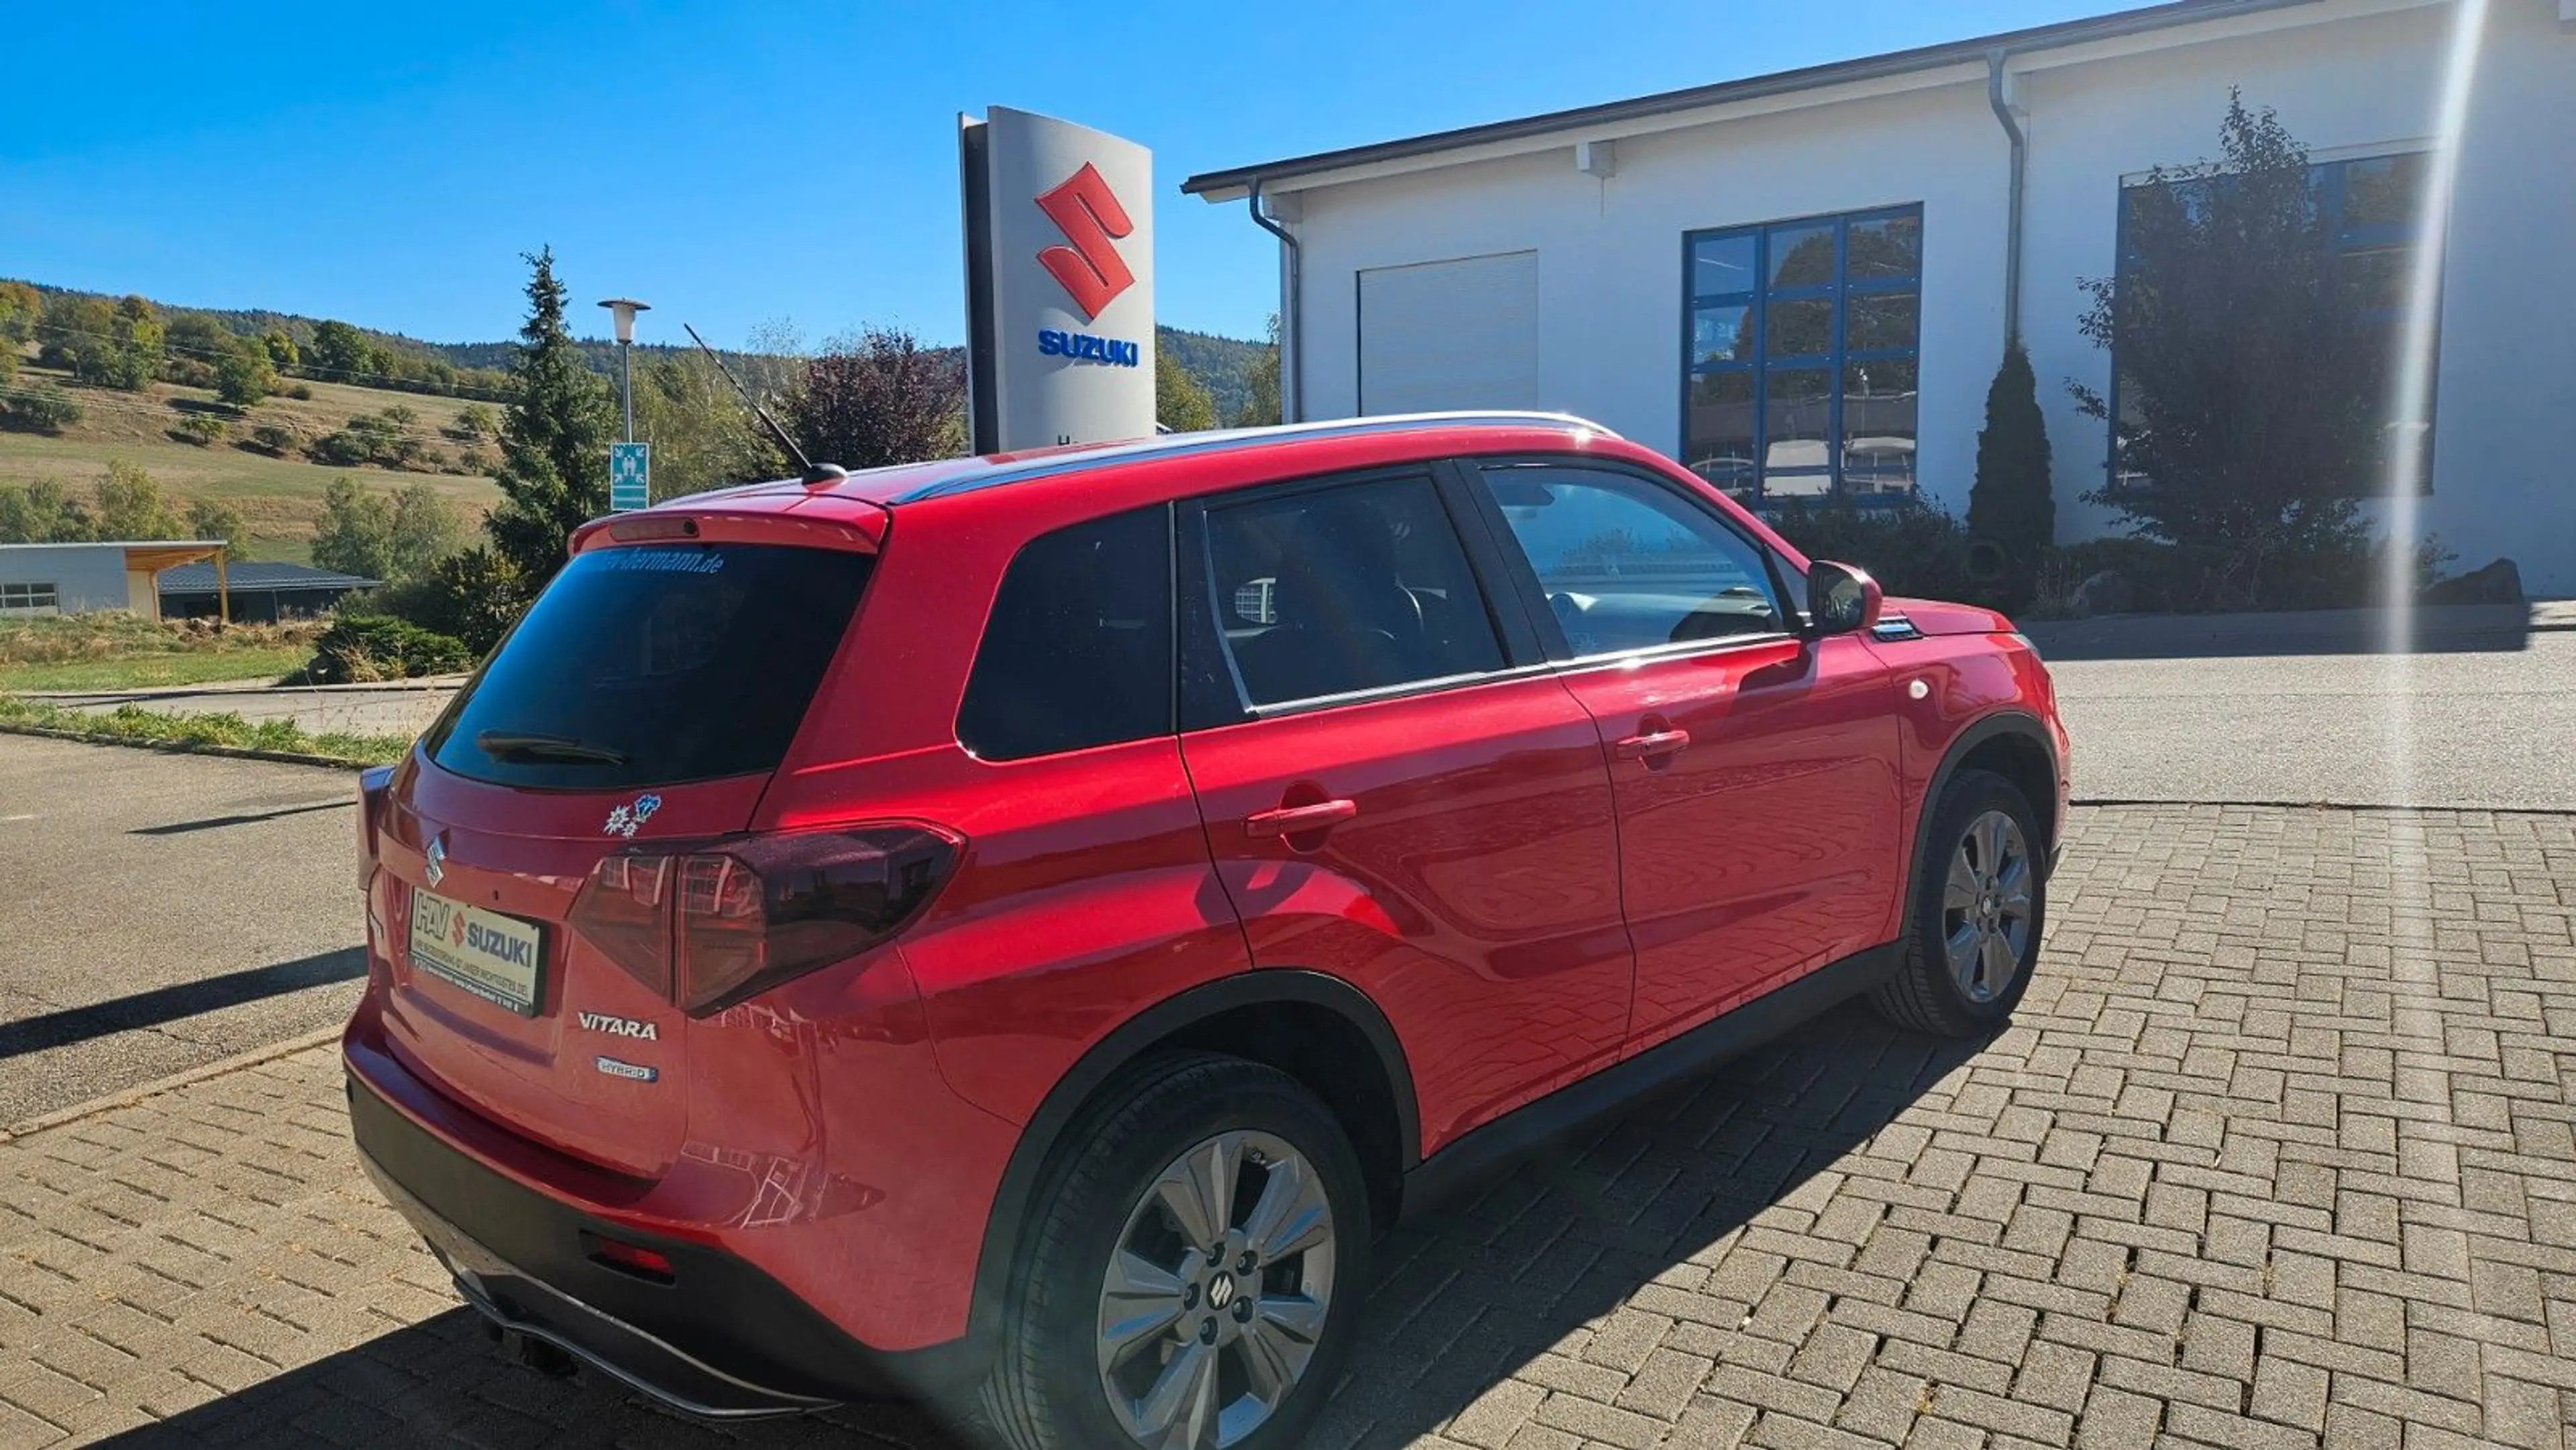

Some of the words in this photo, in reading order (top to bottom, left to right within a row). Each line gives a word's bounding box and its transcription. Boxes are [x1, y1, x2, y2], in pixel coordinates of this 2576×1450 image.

[1038, 329, 1138, 368] SUZUKI
[468, 922, 532, 968] SUZUKI
[578, 1011, 657, 1041] VITARA
